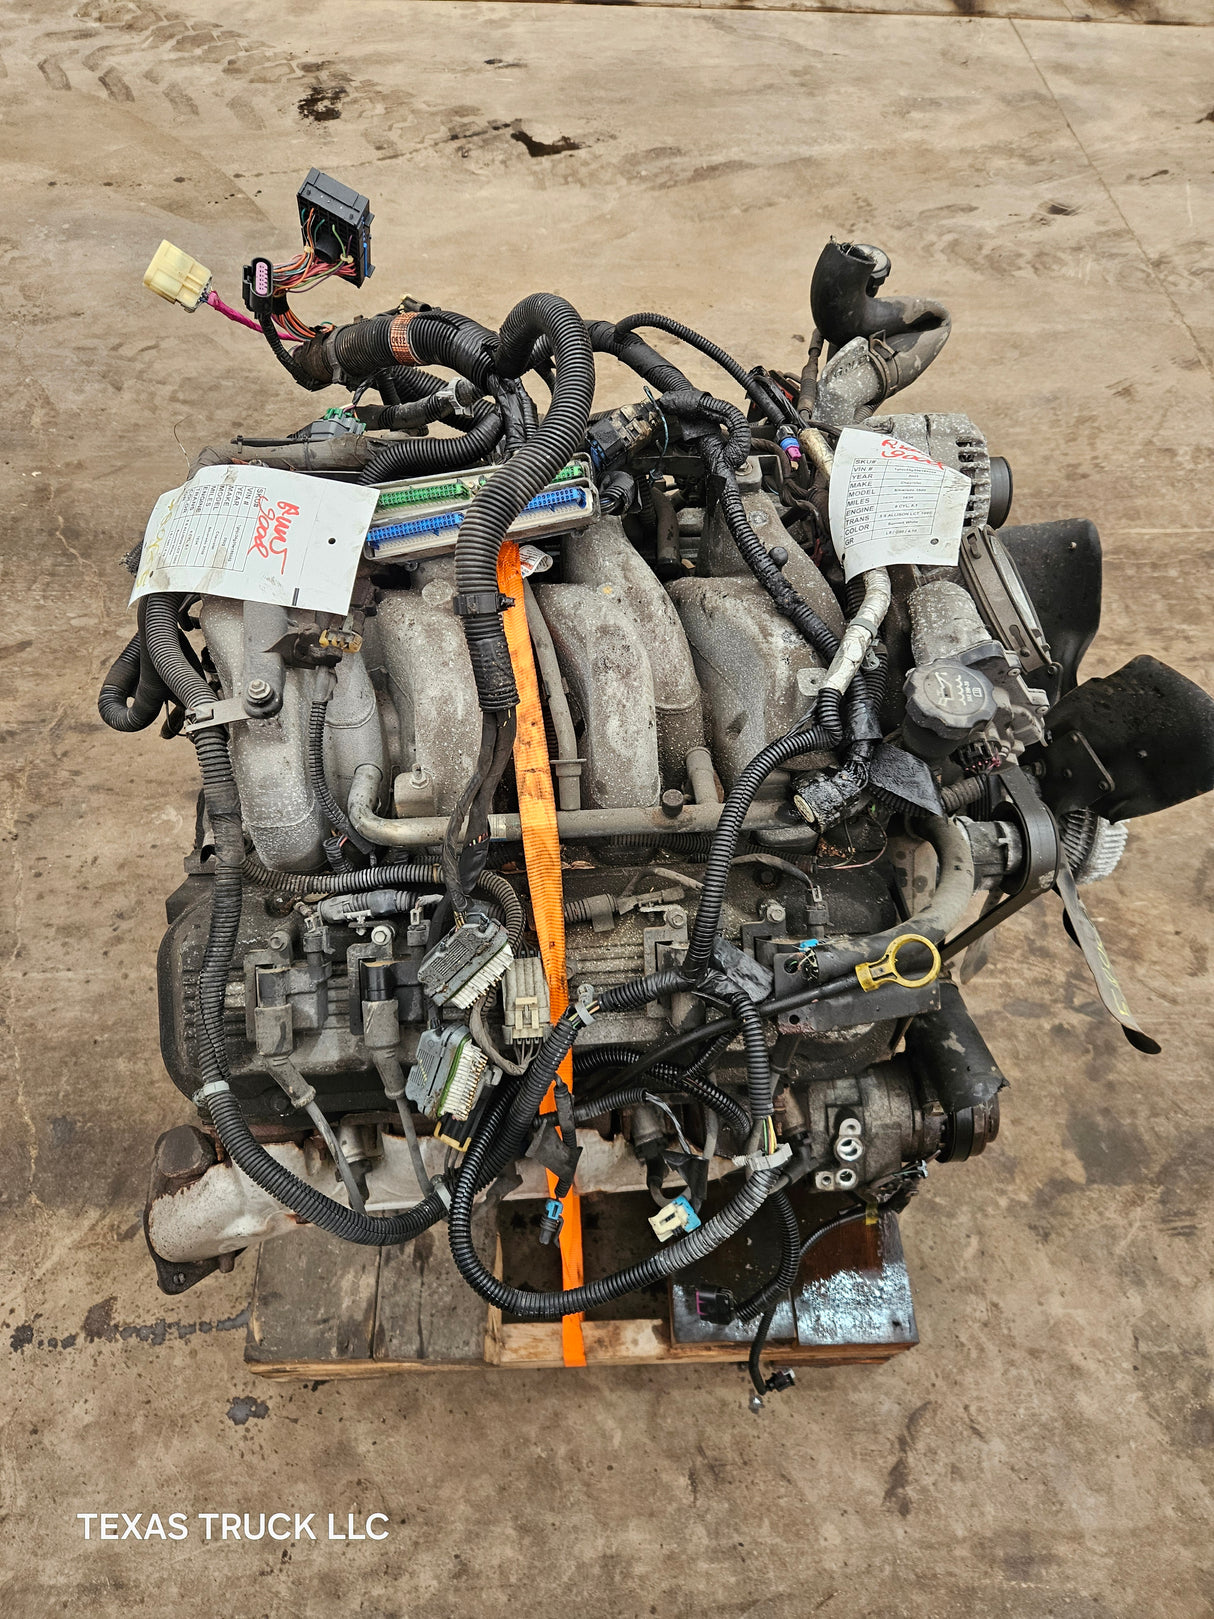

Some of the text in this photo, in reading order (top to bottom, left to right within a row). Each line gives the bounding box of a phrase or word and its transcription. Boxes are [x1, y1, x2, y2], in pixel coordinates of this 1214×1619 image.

[205, 485, 216, 507] MILES
[213, 485, 224, 511] MODEL
[223, 485, 234, 507] MAKE
[233, 486, 243, 507] YEAR
[245, 487, 254, 499] VIN
[848, 489, 875, 498] MODEL
[846, 498, 870, 506] MILES
[846, 506, 875, 516] ENGINE
[845, 516, 870, 526] TRANS
[845, 524, 870, 536] COLOR
[844, 538, 854, 546] GR
